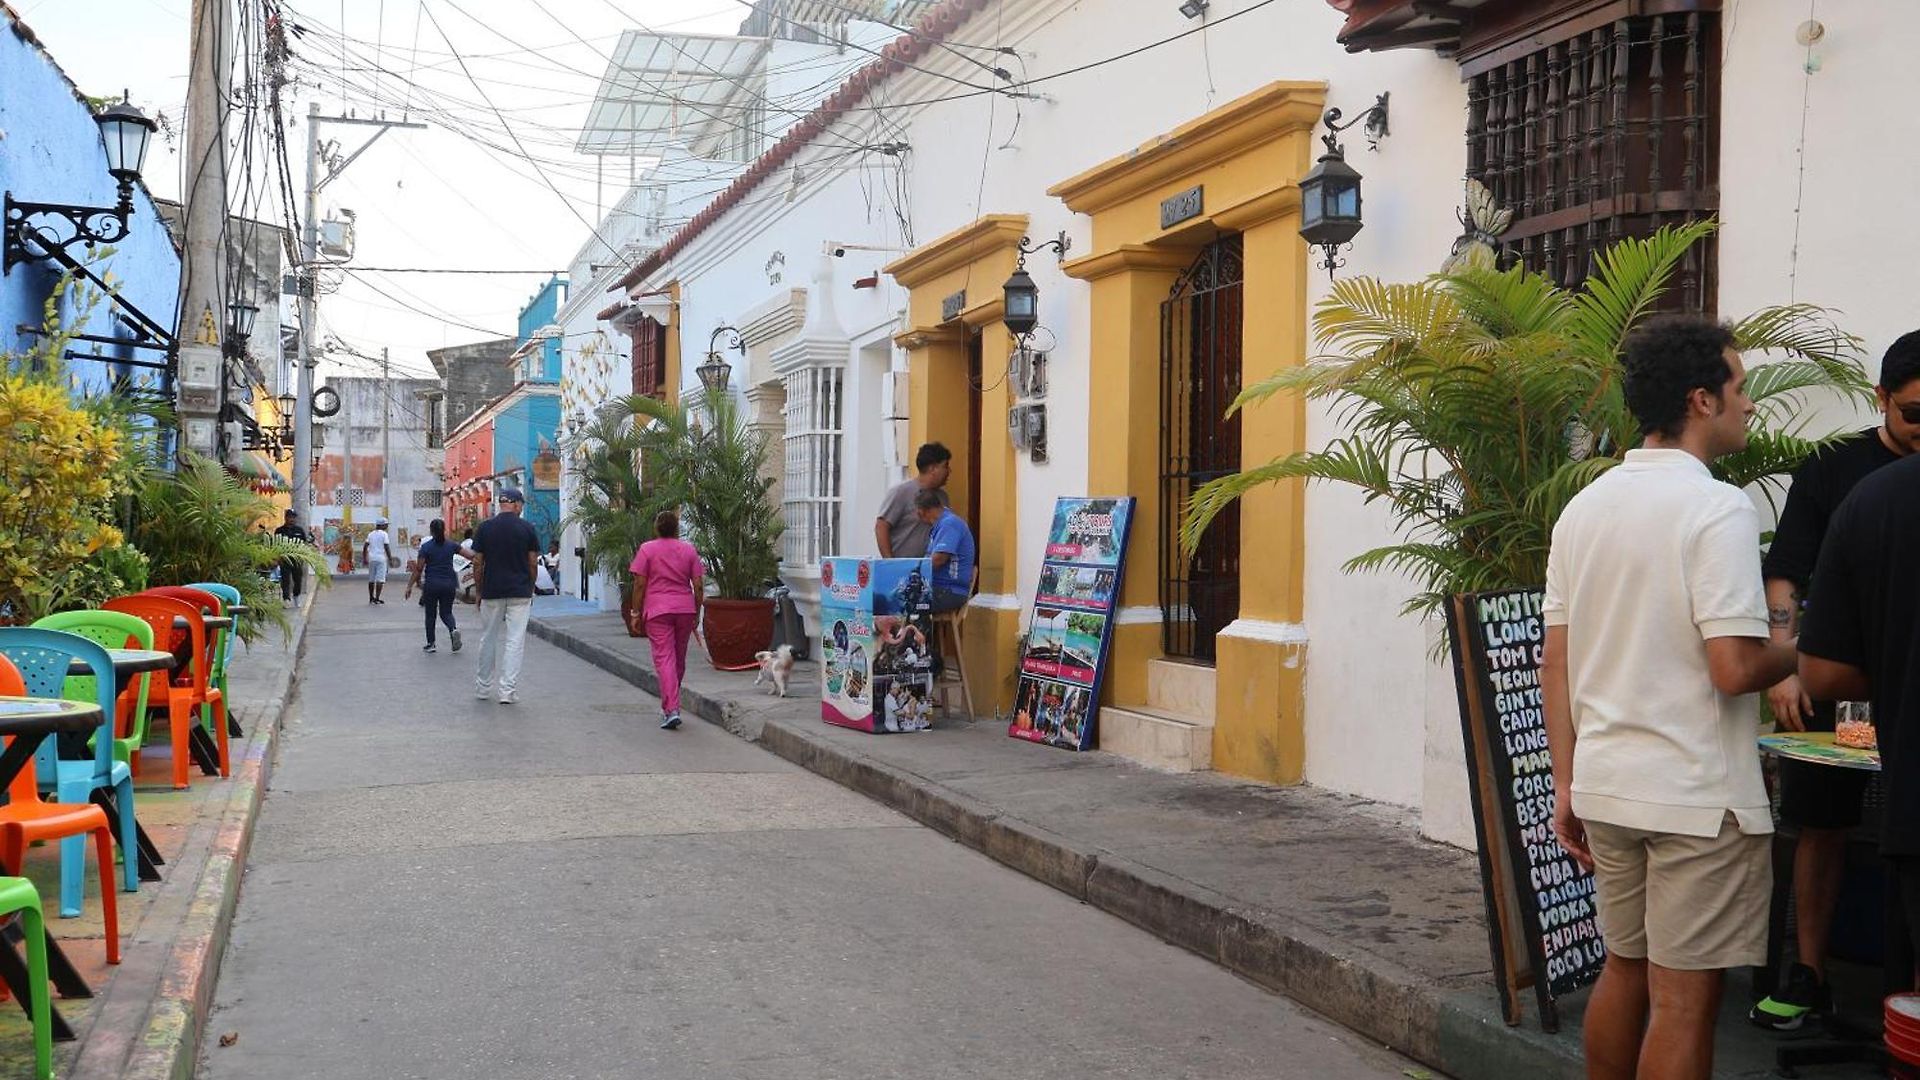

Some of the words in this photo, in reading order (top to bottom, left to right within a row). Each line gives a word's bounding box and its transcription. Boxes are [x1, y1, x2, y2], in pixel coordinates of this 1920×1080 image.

[1481, 592, 1545, 623] MOJIT
[1486, 617, 1541, 648] LONG
[1487, 645, 1528, 670] TOM
[1495, 691, 1525, 715] GIN
[1504, 728, 1548, 756] LONG
[1530, 860, 1574, 892] CUBA
[1538, 898, 1591, 931] VODKA
[1547, 947, 1583, 981] COCO
[1584, 939, 1607, 964] LO
